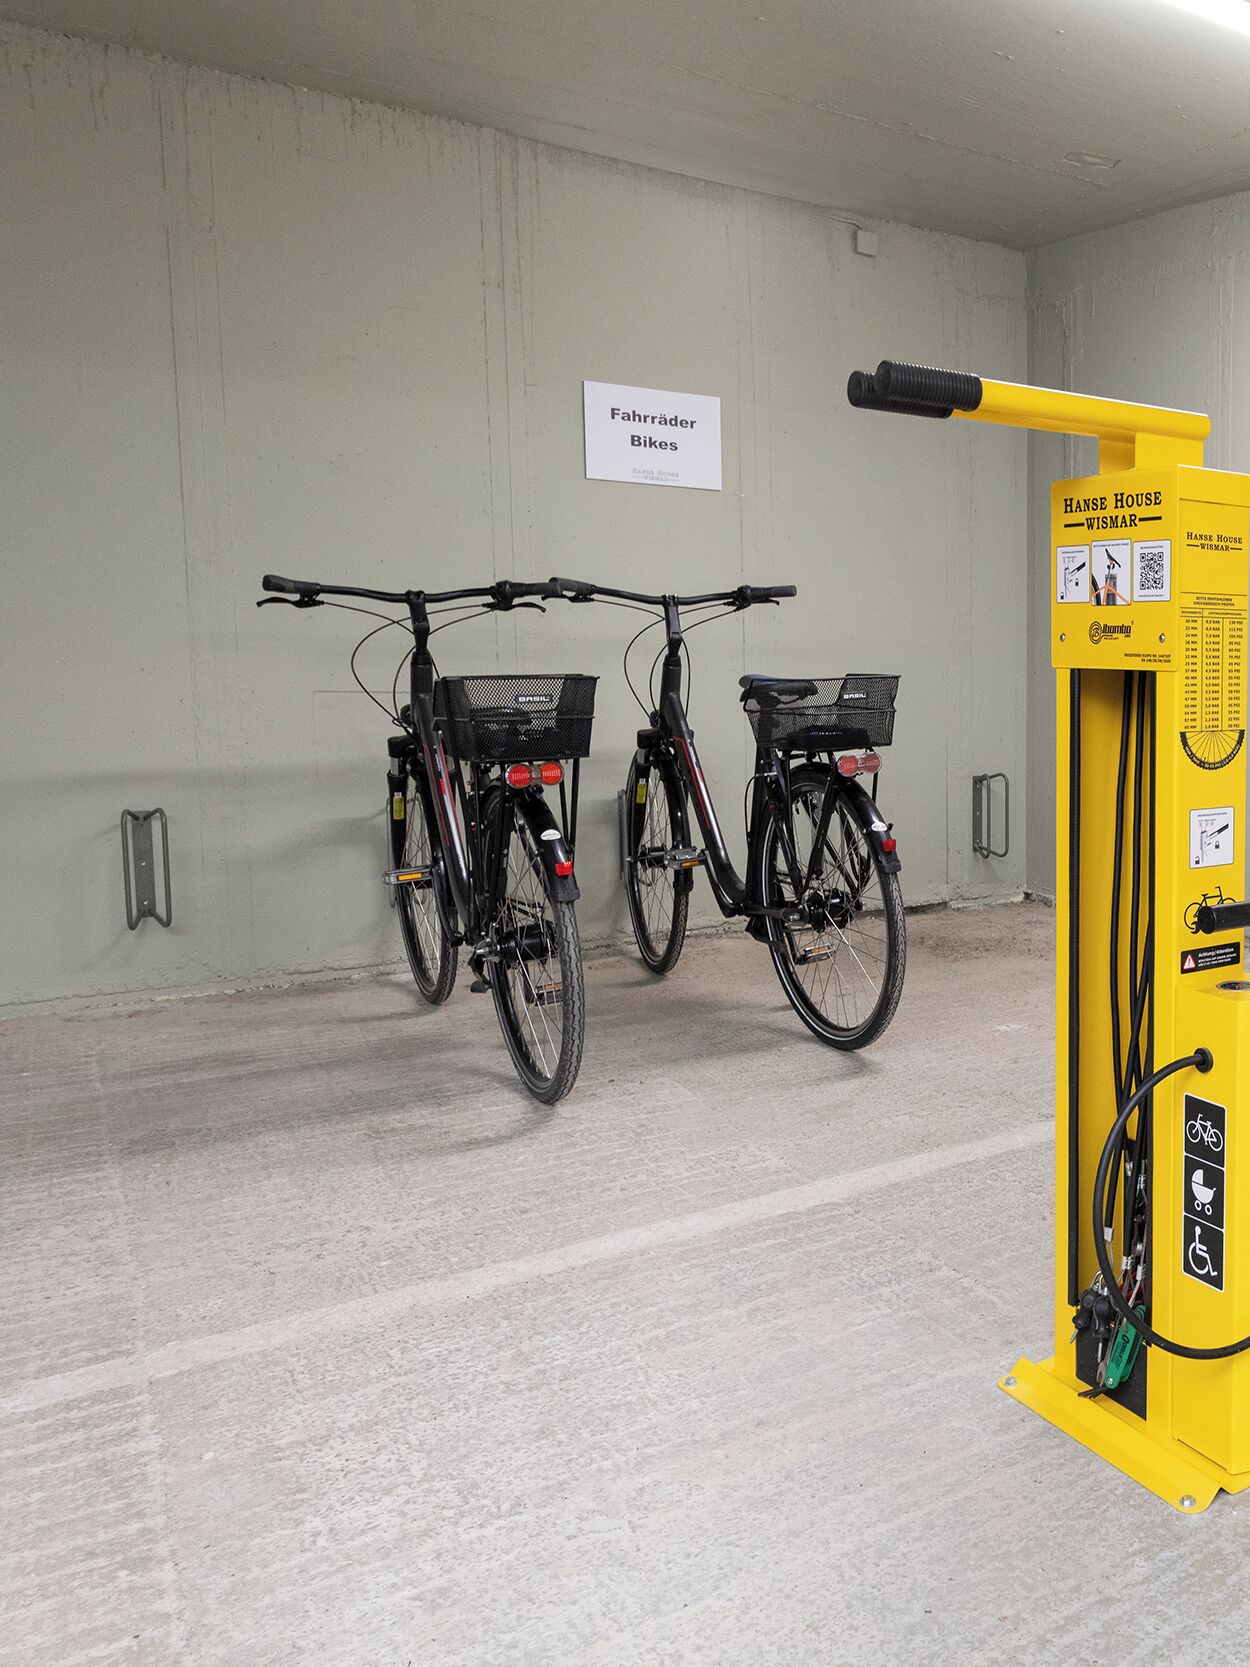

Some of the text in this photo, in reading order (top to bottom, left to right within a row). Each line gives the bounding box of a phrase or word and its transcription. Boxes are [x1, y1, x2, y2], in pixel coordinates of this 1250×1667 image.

[611, 408, 696, 429] Fahrräder
[631, 434, 678, 451] Bikes
[1064, 491, 1162, 514] HANSE HOUSE
[1085, 514, 1137, 530] WISMAR
[1187, 532, 1243, 544] HANSE HOUSE
[1200, 543, 1230, 551] WISMAR
